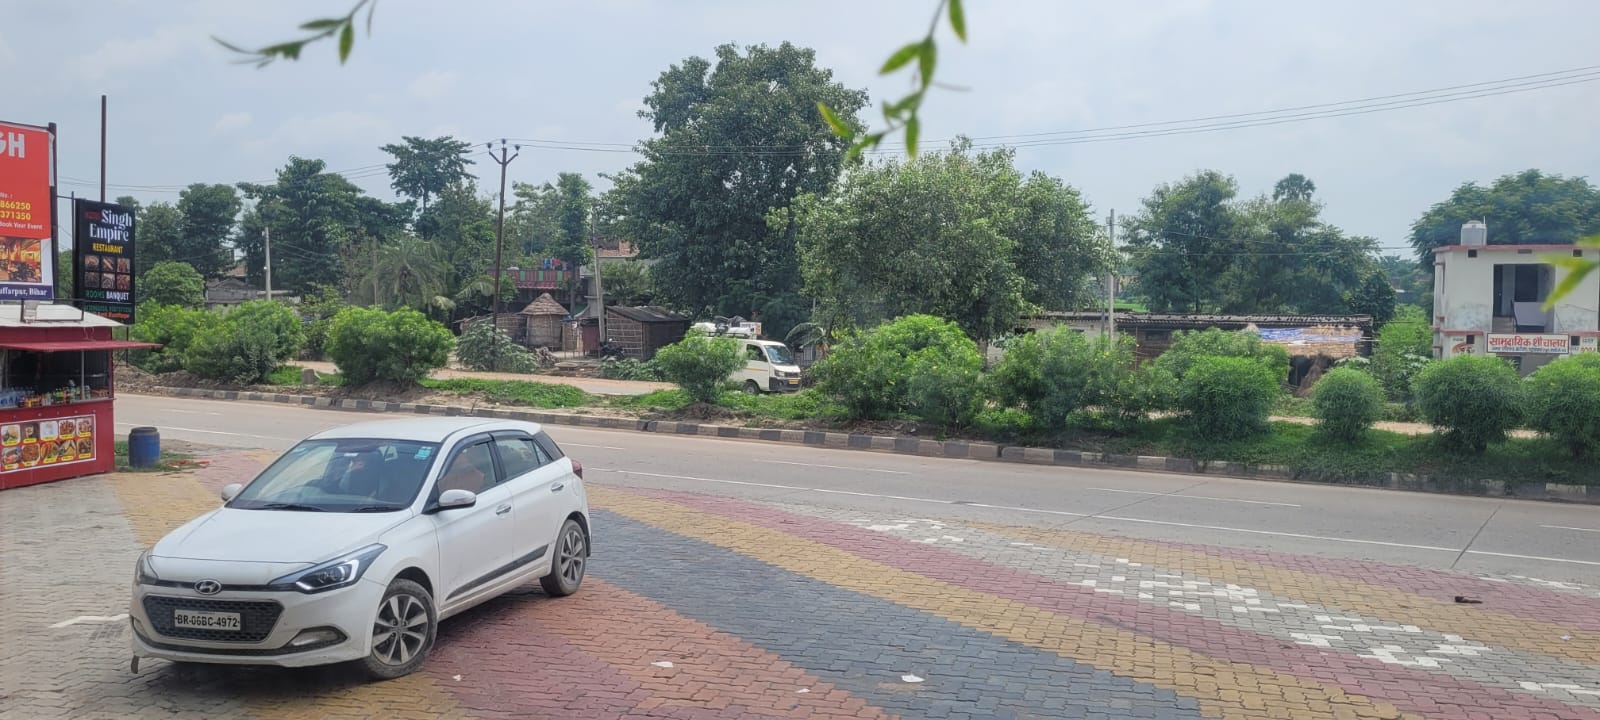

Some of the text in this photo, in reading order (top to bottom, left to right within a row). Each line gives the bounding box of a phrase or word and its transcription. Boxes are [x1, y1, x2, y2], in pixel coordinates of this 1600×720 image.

[101, 209, 132, 230] Singh
[90, 223, 129, 243] Empire
[106, 291, 129, 301] BANQUET
[1489, 336, 1566, 348] सामुदायिक शौचालय
[177, 614, 238, 627] BR-06BC-4972
